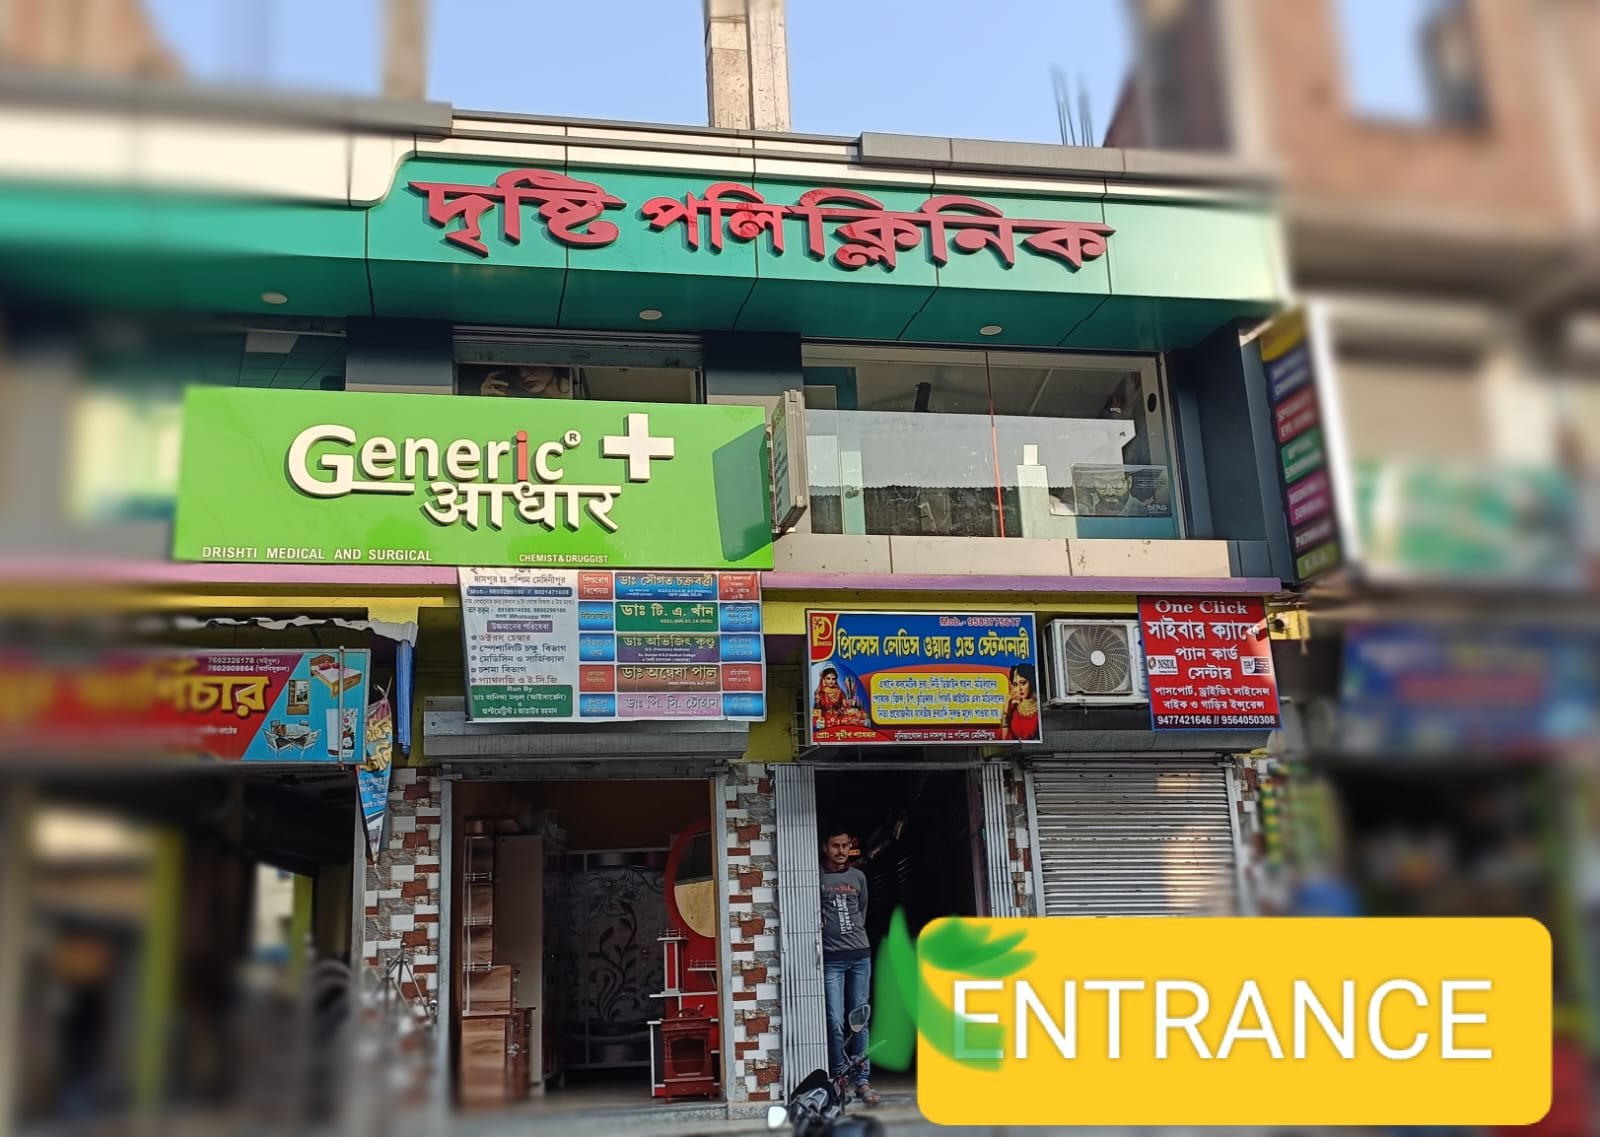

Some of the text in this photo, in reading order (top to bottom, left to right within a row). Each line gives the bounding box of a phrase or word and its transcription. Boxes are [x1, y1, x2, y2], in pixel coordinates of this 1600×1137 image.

[407, 168, 1116, 273] দৃষ্টি পলিক্লিনিক
[288, 424, 564, 496] Generic
[424, 481, 622, 533] आधार
[202, 546, 433, 561] DRISHTI MEDICAL AND SURGICAL
[519, 553, 609, 563] CHEMIST&DRUGGIST
[618, 575, 637, 587] ডাঃ
[619, 603, 646, 617] ডাঃ
[650, 603, 668, 617] টি.
[672, 607, 686, 617] এ.
[1155, 600, 1248, 614] One Click
[1145, 615, 1206, 641] সাইবার
[623, 637, 643, 647] ডাঃ
[645, 634, 692, 647] অভিজিৎ
[837, 627, 1030, 660] প্রিন্সেস লেডিস ওয়ার এন্ড স্টেশনারী
[542, 643, 567, 653] বিভাগ
[1175, 644, 1238, 661] প্যান কার্ড
[480, 654, 514, 662] মেডিসিন
[501, 664, 527, 673] বিভাগ
[621, 667, 644, 680] ডাঃ
[645, 666, 688, 680] অন্বেষা
[692, 666, 717, 680] পাল
[1188, 663, 1232, 680] সেন্টার
[625, 697, 644, 709] ডাঃ
[647, 695, 663, 709] পি.
[667, 695, 681, 708] সি.
[1163, 698, 1188, 709] বাইক
[1158, 715, 1212, 725] 9477421646
[1221, 715, 1276, 725] 9564050308
